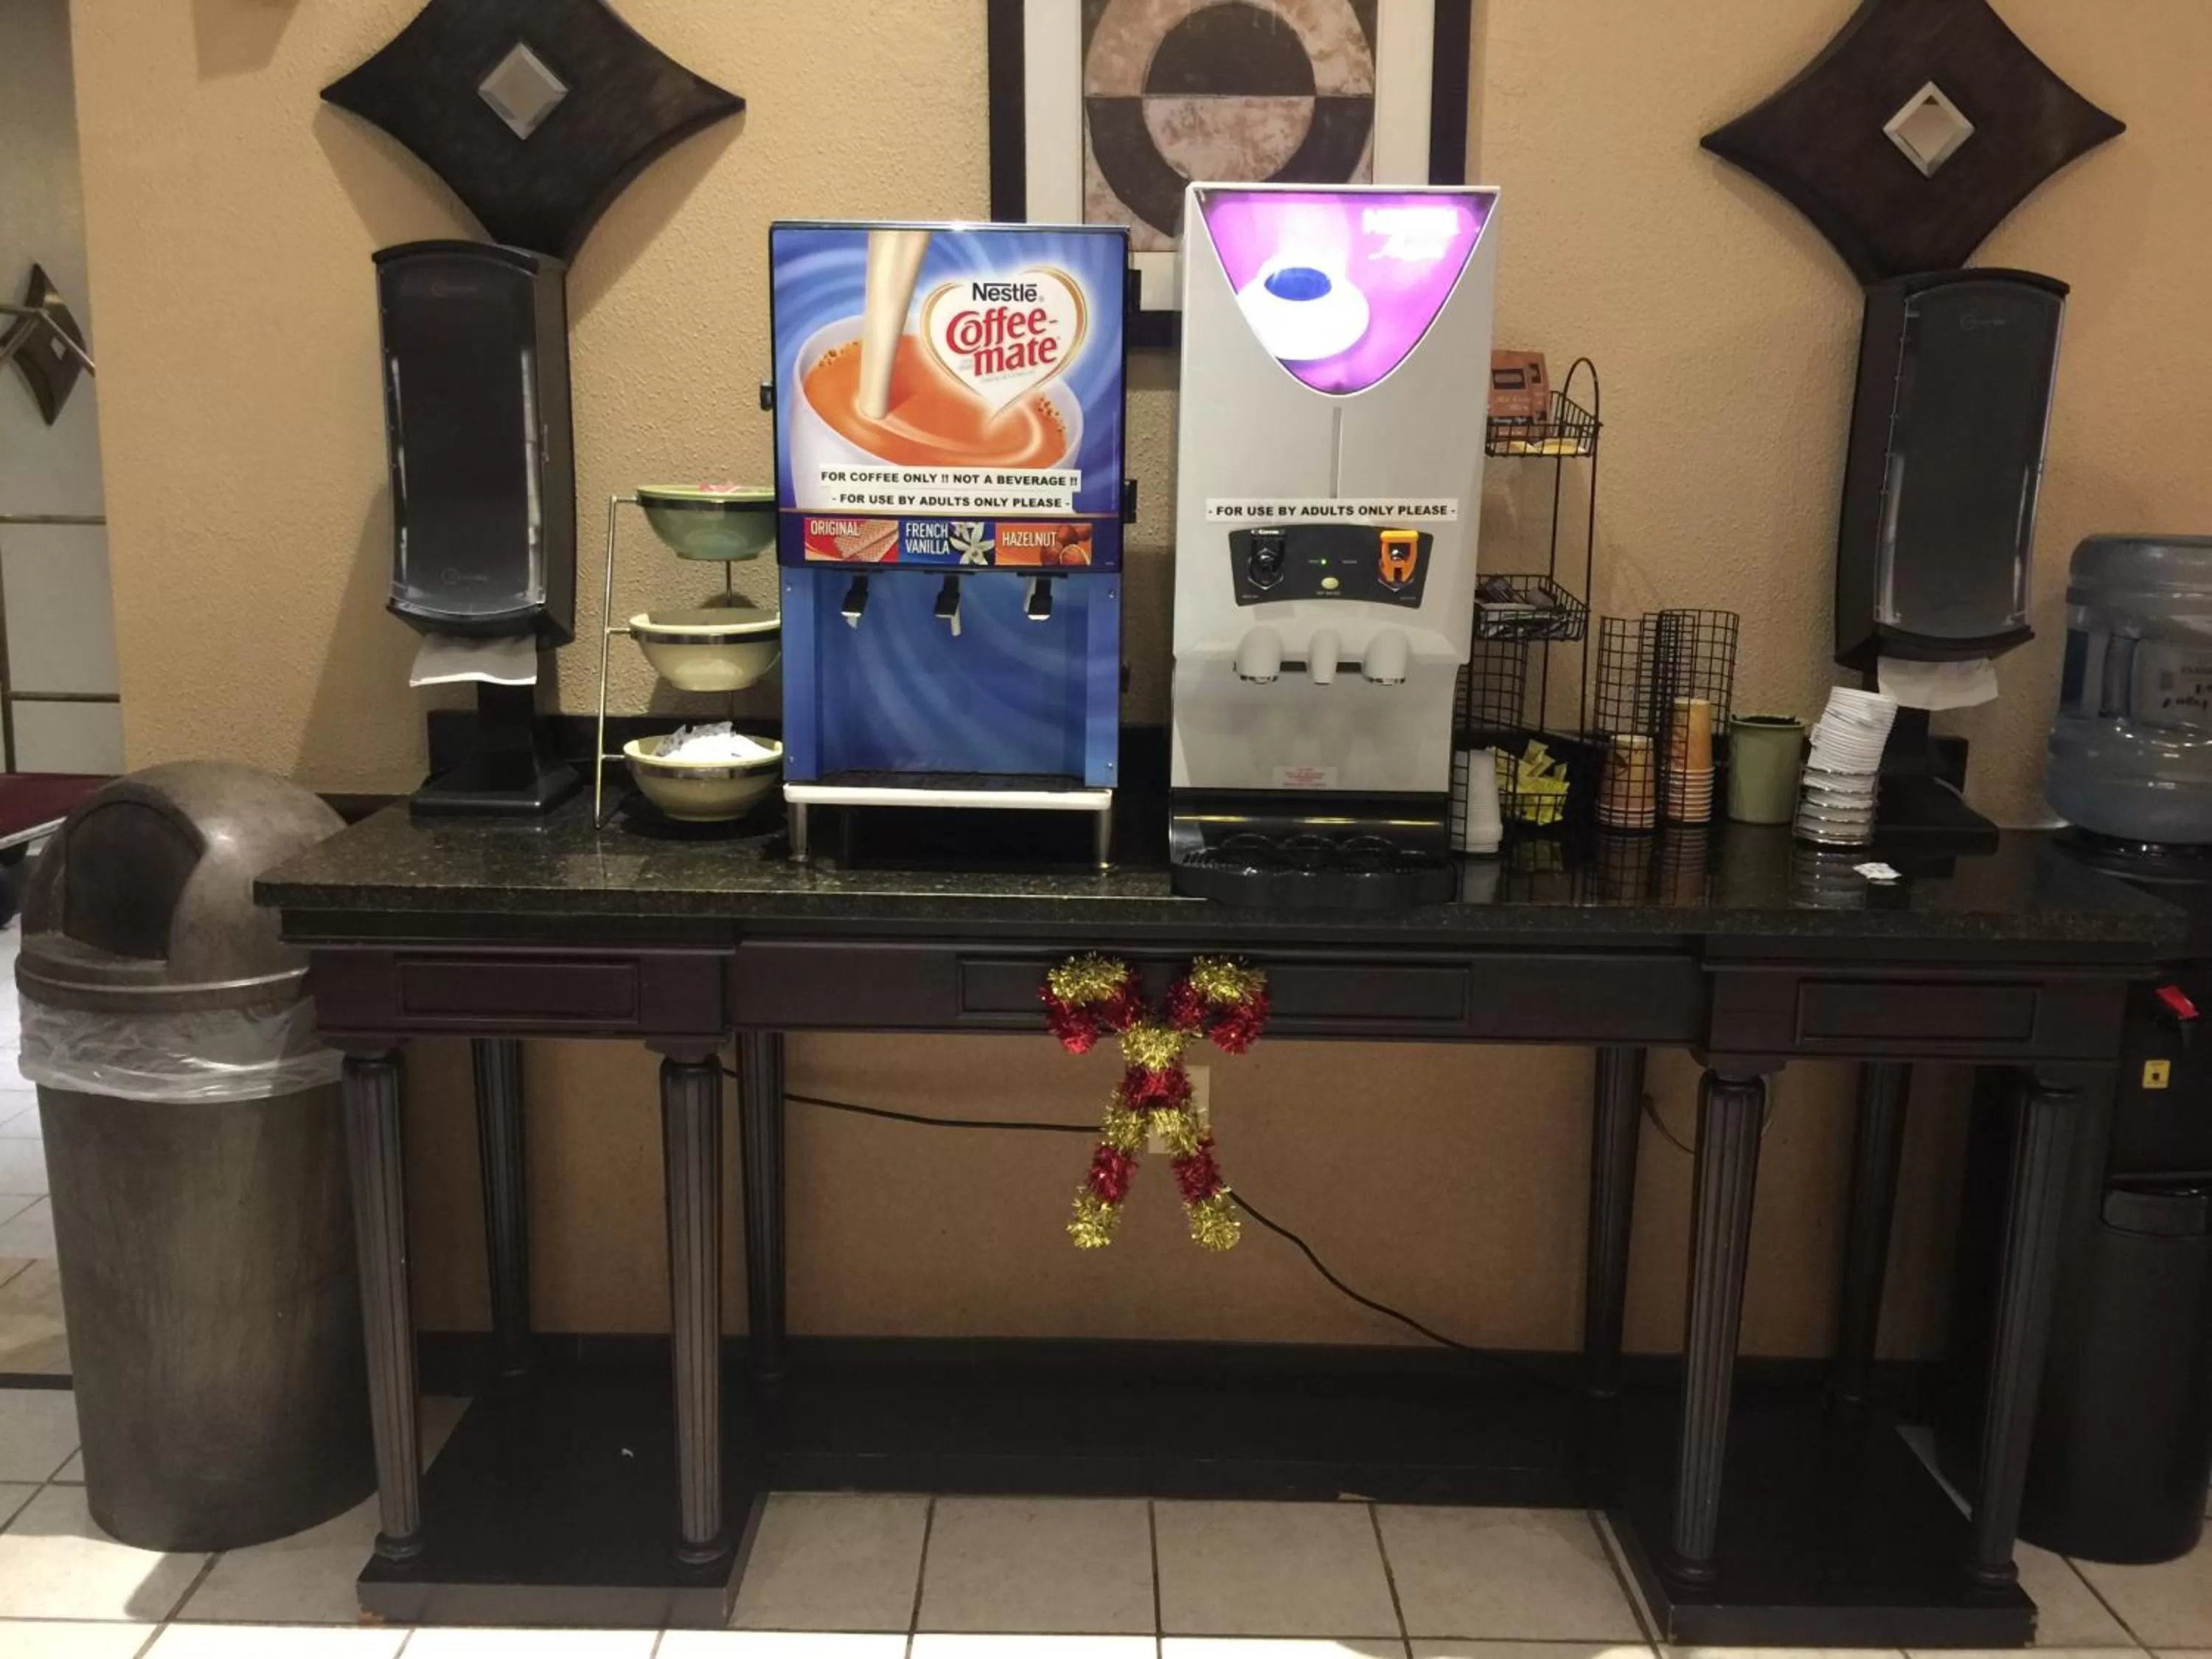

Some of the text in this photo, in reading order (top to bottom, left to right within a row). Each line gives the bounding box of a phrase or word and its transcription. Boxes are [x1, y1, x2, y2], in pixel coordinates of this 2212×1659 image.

[973, 337, 1057, 377] mate
[821, 471, 846, 481] FOR
[850, 472, 899, 482] COFFEE
[904, 473, 937, 483] ONLY
[953, 474, 979, 484] NOT
[984, 475, 992, 484] A
[997, 475, 1066, 486] BEVERAGE
[840, 493, 865, 504] FOR
[869, 495, 894, 504] USE
[899, 495, 915, 505] BY
[919, 496, 970, 507] ADULTS
[974, 497, 1008, 507] ONLY
[1012, 498, 1062, 507] PLEASE
[1217, 506, 1242, 516] FOR
[1248, 506, 1274, 516] USE
[1278, 506, 1296, 515] BY
[1301, 506, 1354, 516] ADULTS
[1358, 506, 1394, 515] ONLY
[1398, 505, 1447, 515] PLEASE
[810, 520, 860, 536] ORIGINAL
[905, 522, 948, 538] FRENCH
[905, 538, 950, 554] VANILLA
[1002, 531, 1057, 547] HAZELNUT
